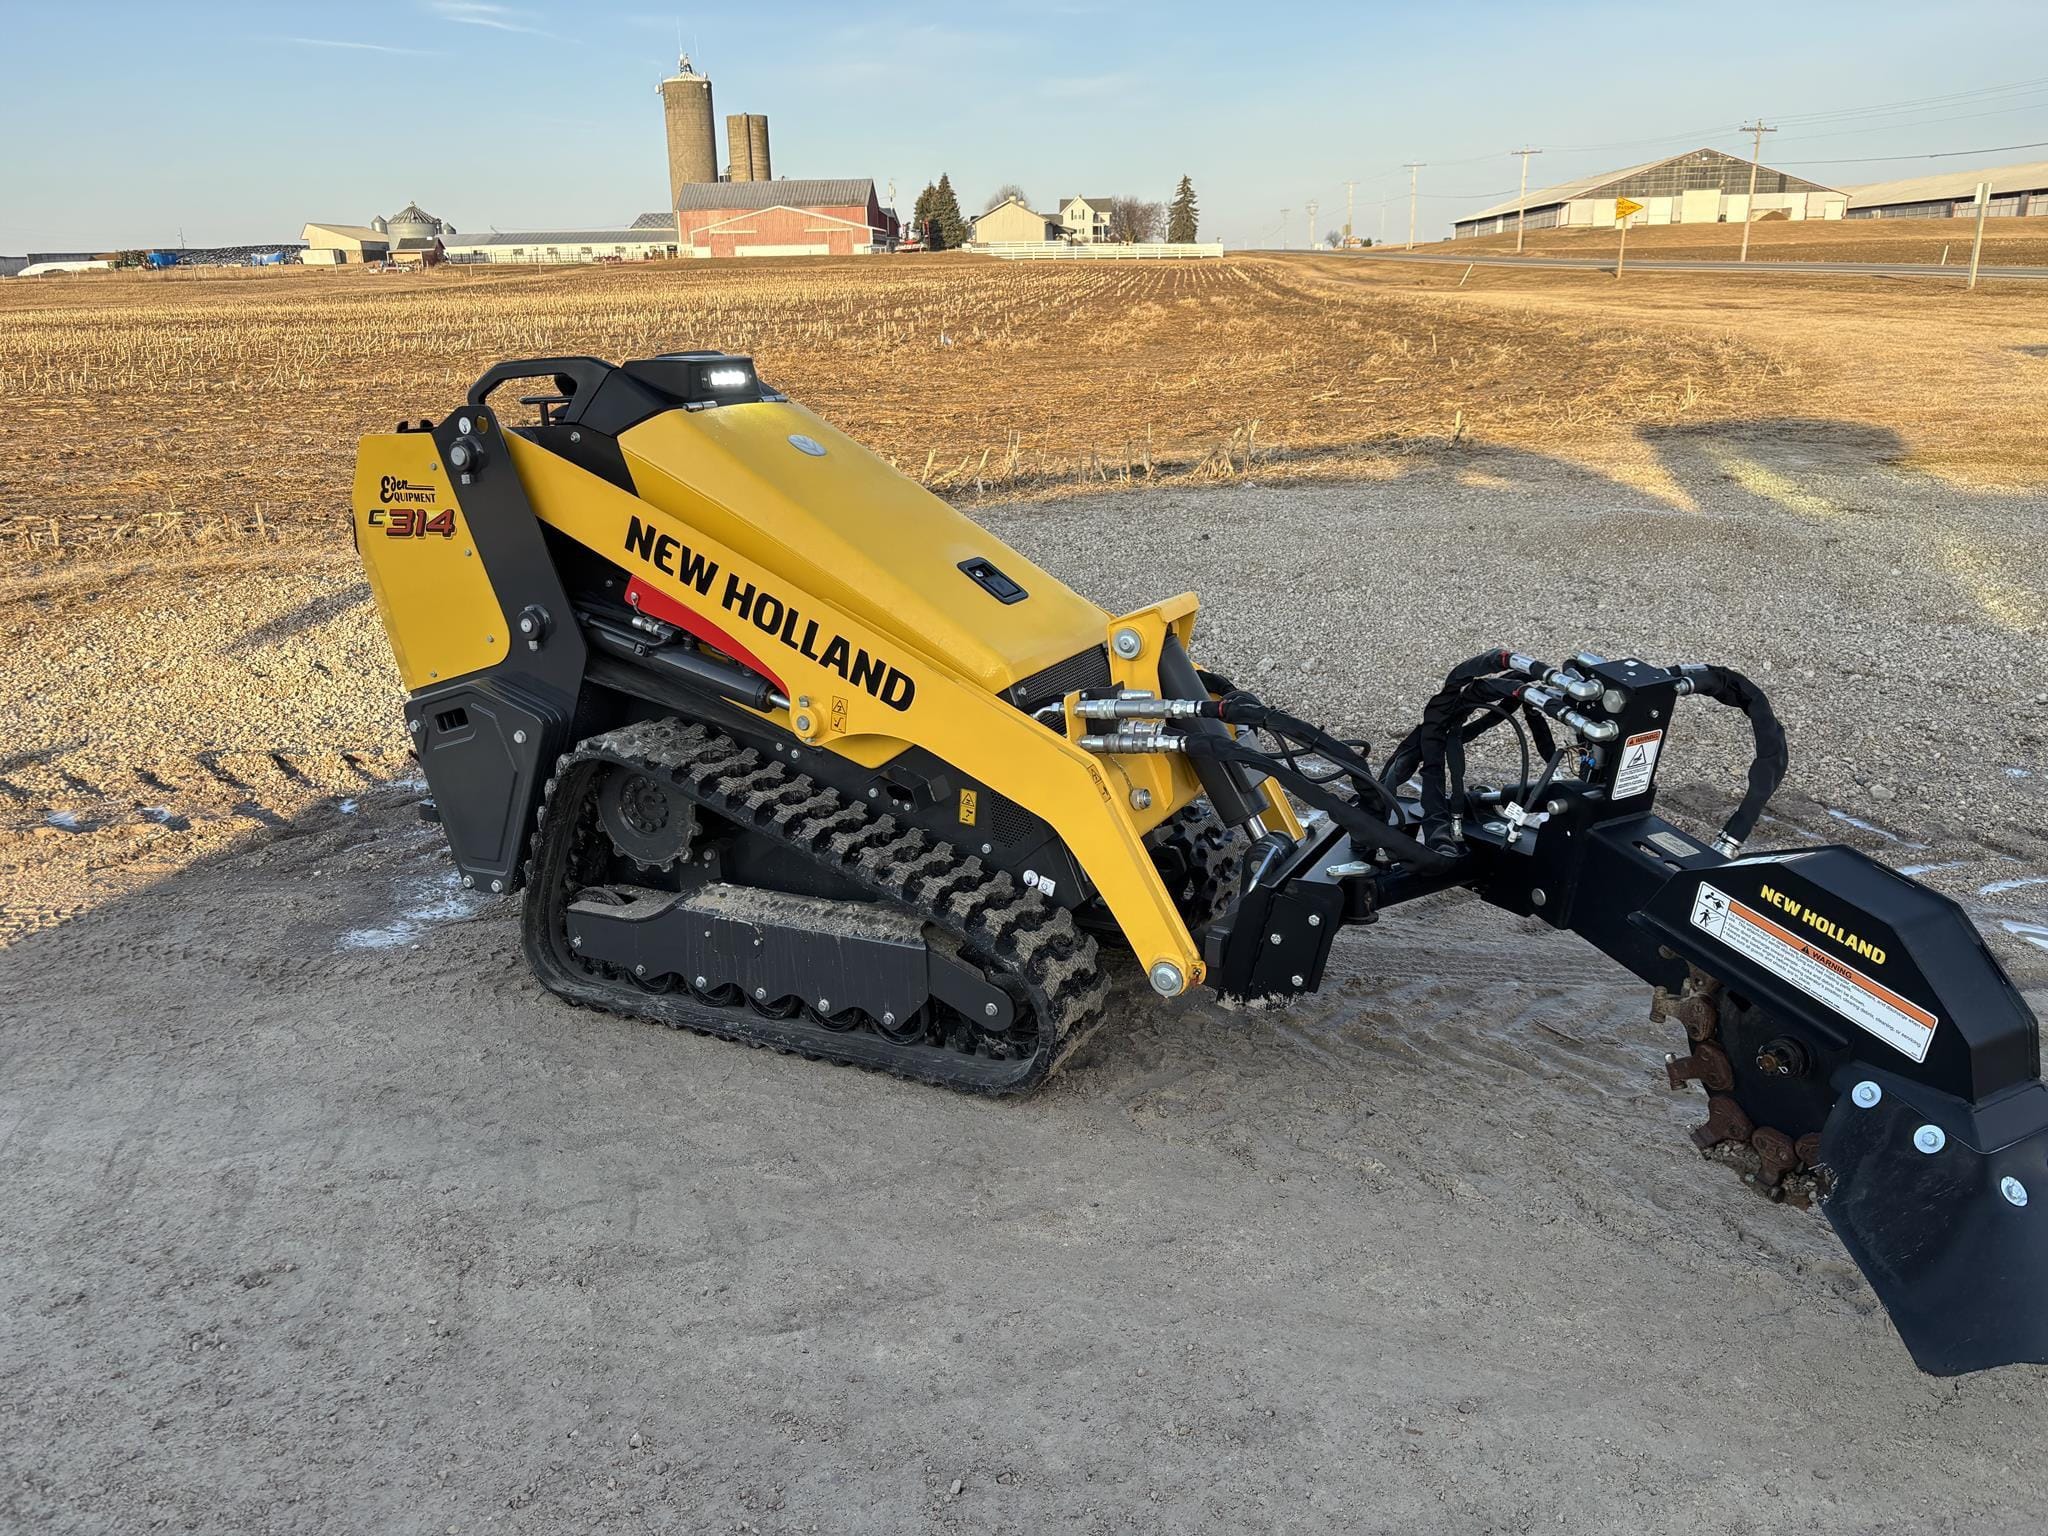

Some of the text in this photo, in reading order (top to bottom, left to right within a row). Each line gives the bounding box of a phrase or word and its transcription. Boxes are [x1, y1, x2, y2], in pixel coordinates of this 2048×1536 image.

[624, 515, 916, 713] NEW HOLLAND
[1760, 884, 1886, 965] NEW HOLLAND
[1811, 950, 1852, 979] WARNING
